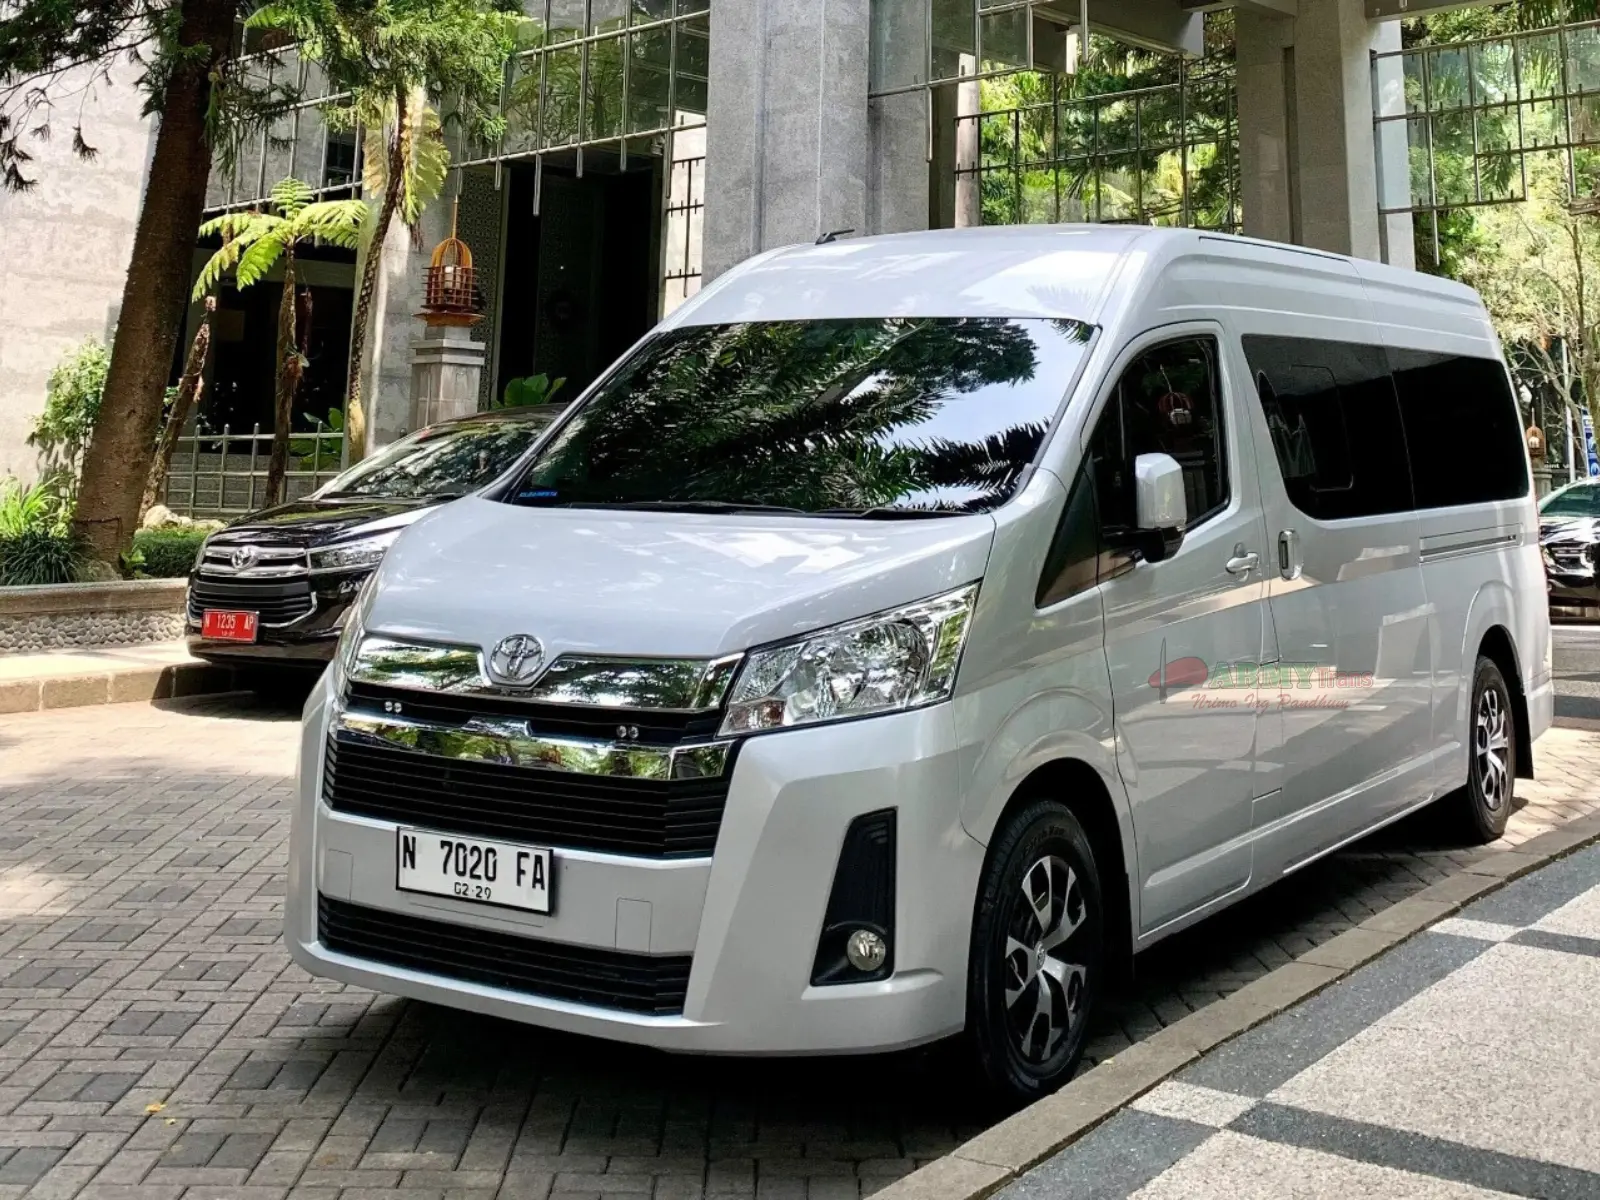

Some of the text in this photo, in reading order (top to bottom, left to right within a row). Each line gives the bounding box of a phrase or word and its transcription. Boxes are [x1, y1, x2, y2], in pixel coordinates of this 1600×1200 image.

[205, 614, 253, 630] N 1235 AP
[402, 835, 546, 890] N 7020 FA
